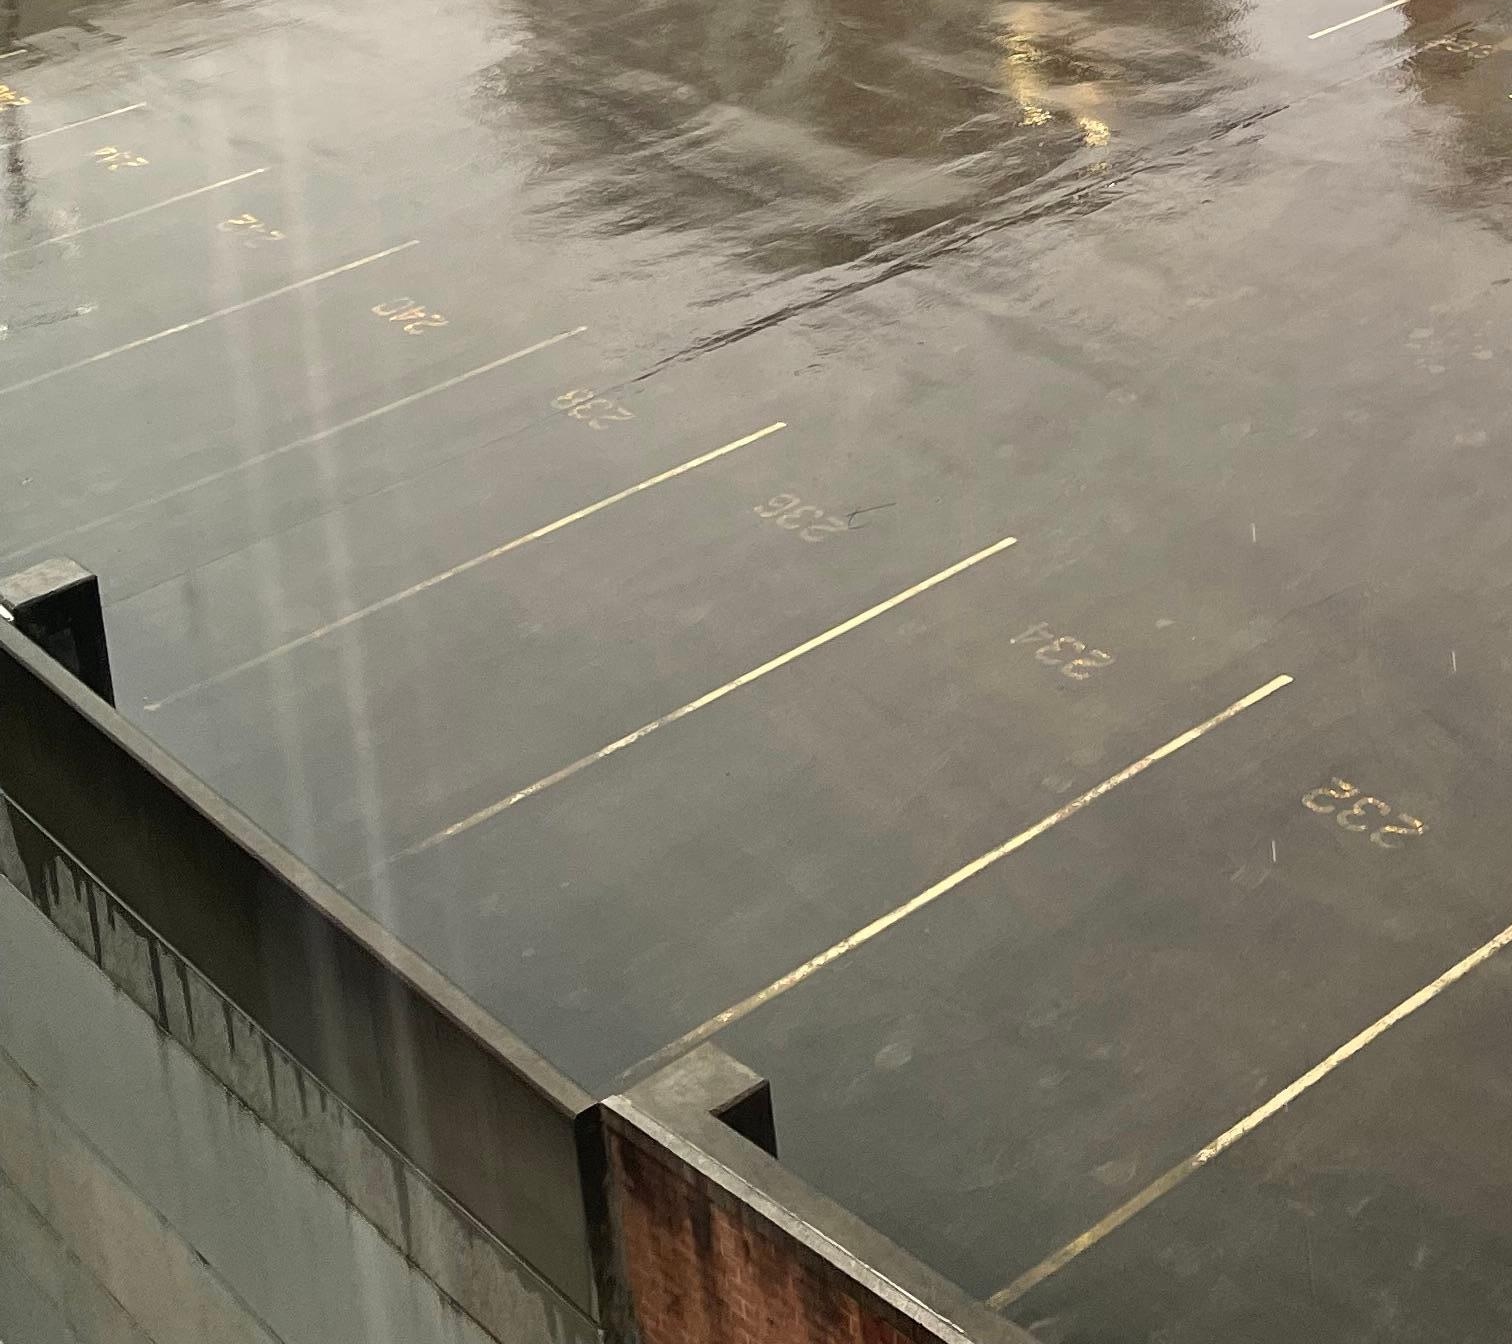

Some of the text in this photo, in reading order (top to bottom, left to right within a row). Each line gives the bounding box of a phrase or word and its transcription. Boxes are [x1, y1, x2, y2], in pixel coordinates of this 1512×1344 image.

[752, 493, 849, 543] 236
[1009, 622, 1116, 680] 234
[1301, 776, 1427, 849] 232
